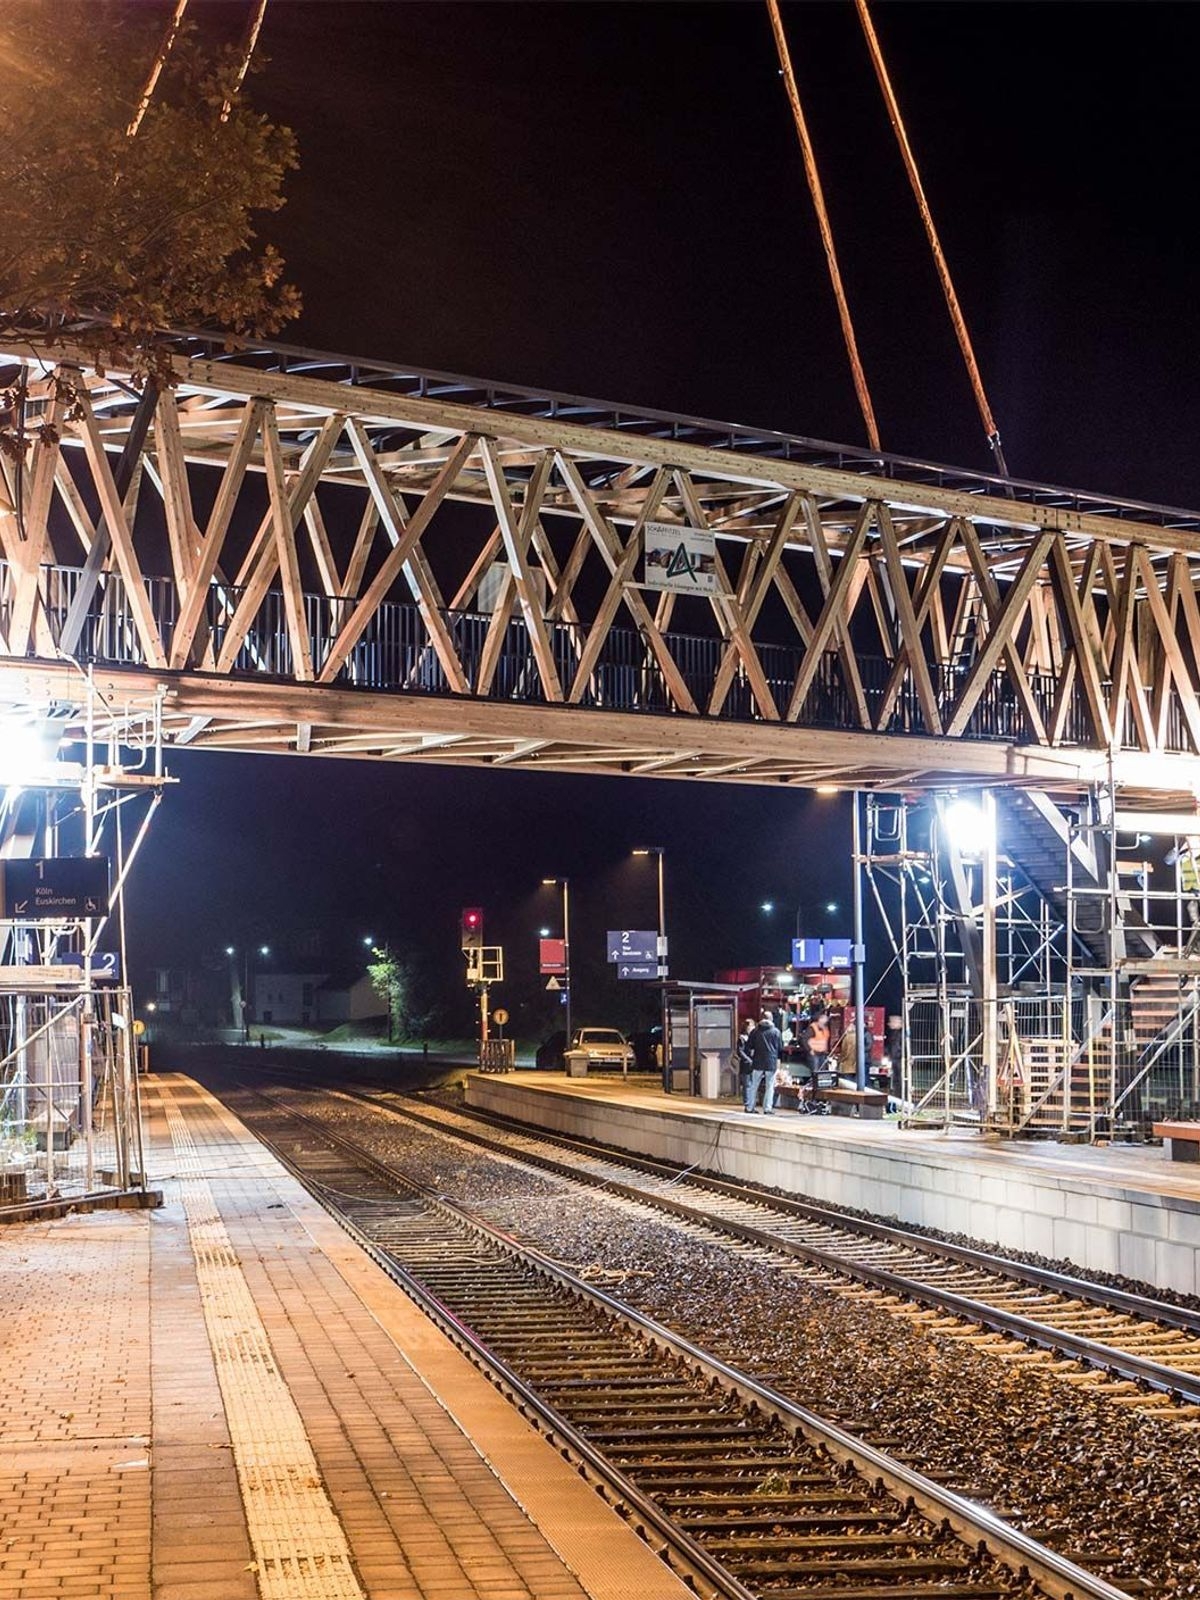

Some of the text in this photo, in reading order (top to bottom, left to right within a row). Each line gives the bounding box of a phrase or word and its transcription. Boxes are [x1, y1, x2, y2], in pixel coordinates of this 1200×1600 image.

[35, 860, 44, 879] 1
[35, 885, 53, 895] Köln
[35, 894, 76, 905] Euskirchen
[622, 931, 630, 943] 2
[795, 939, 805, 962] 1
[102, 952, 116, 970] 2
